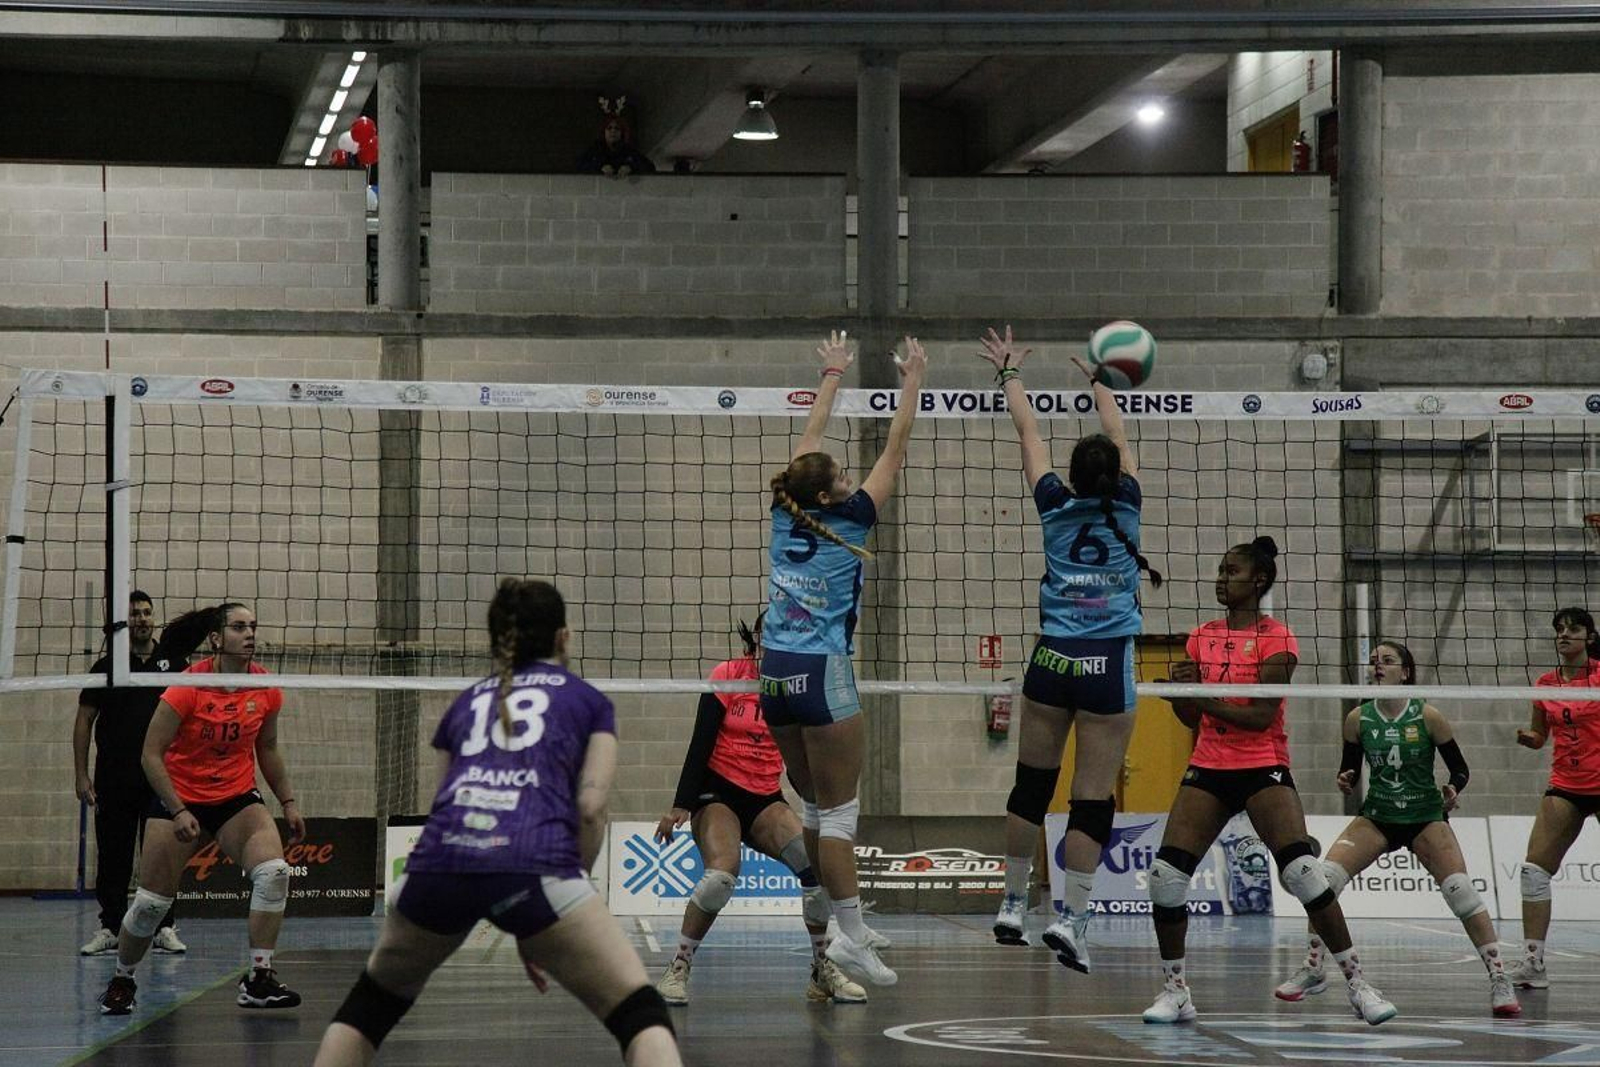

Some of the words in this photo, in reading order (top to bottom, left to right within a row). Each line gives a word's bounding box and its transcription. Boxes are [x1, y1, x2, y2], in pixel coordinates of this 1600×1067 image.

[604, 391, 657, 401] ourense
[869, 392, 935, 411] CLB
[942, 393, 1068, 413] VOLEOL
[1073, 394, 1193, 414] ORENSE
[1311, 394, 1362, 414] SOUSAS
[1503, 397, 1530, 406] ABRIL
[785, 523, 818, 563] 5
[1069, 523, 1110, 566] 6
[1034, 646, 1069, 674] ASEO
[1218, 662, 1230, 684] 7
[221, 722, 241, 741] 13
[461, 688, 550, 756] 18
[1387, 744, 1404, 770] 4
[176, 890, 204, 900] Emilio
[326, 889, 371, 898] OURENSE
[1108, 901, 1153, 914] OFICI
